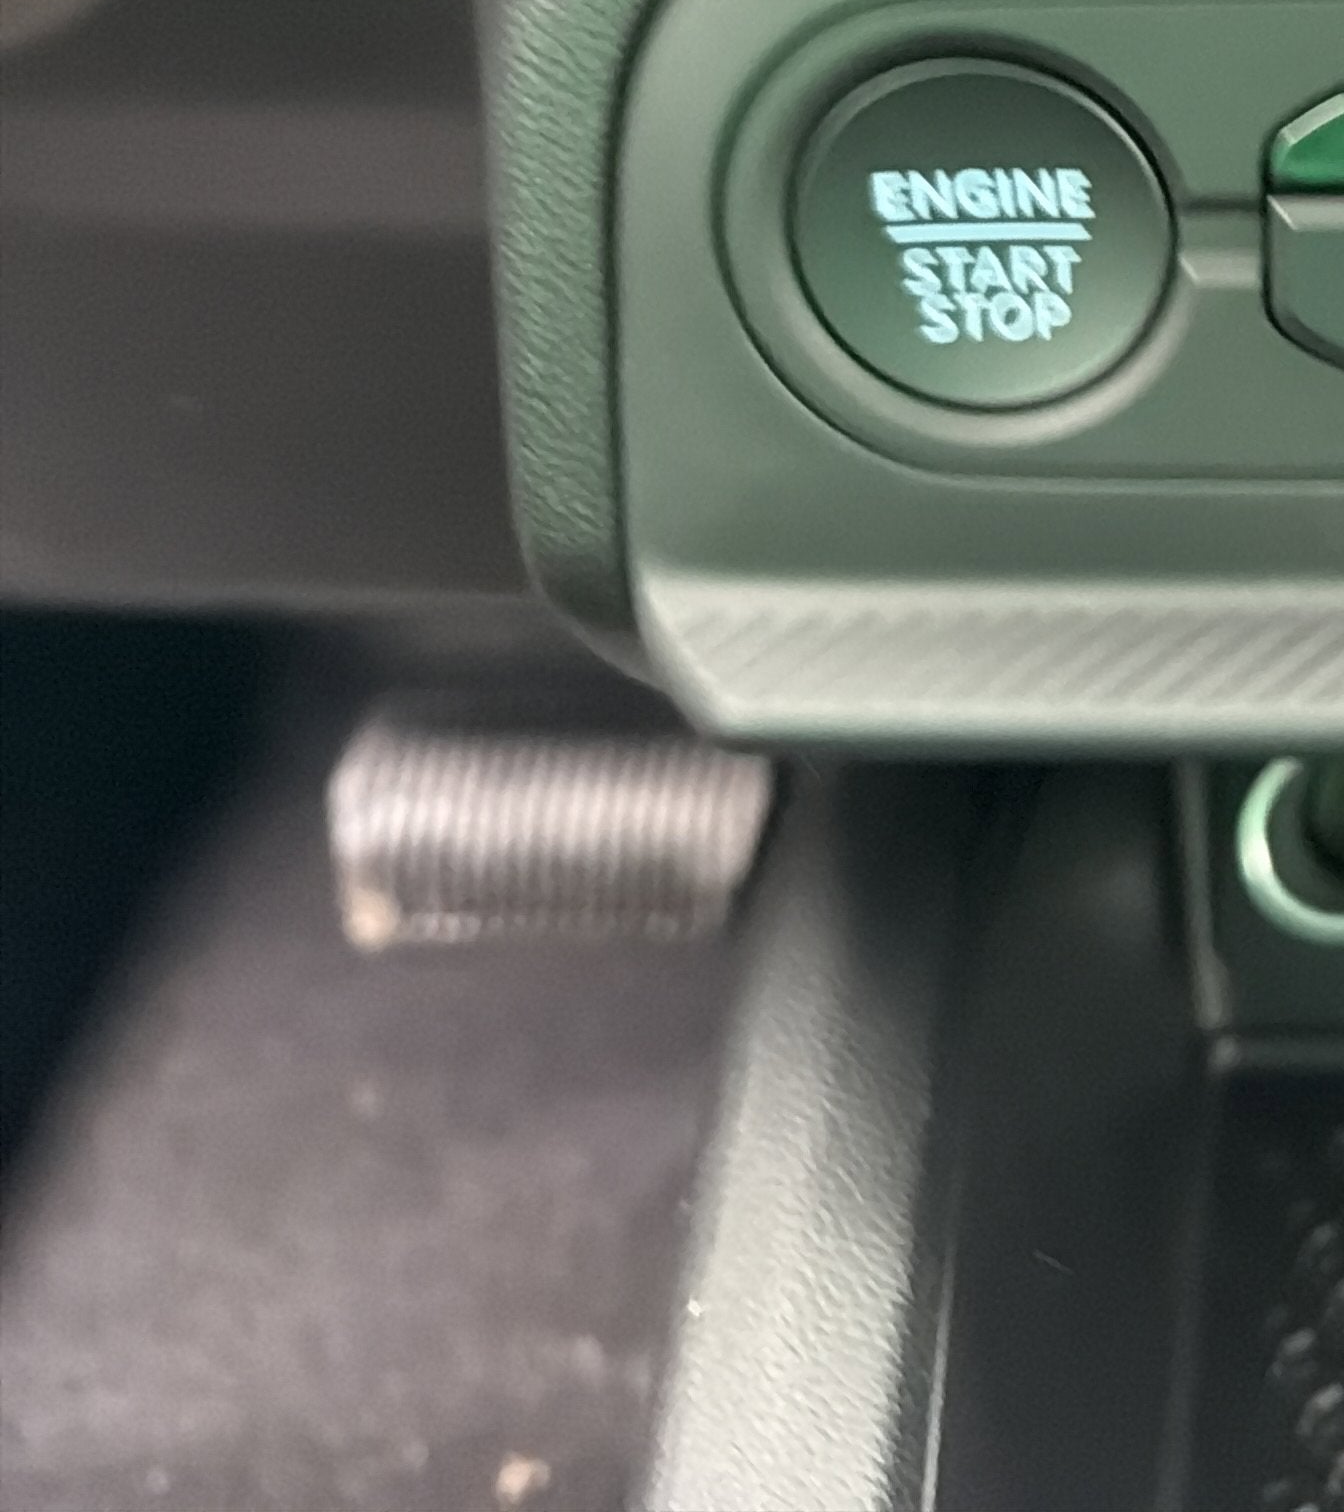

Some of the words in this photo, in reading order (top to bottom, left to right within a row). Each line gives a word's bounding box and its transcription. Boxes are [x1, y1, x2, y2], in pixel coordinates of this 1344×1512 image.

[869, 167, 1096, 221] ENGINE
[901, 245, 1082, 296] START
[918, 290, 1073, 344] STOP
